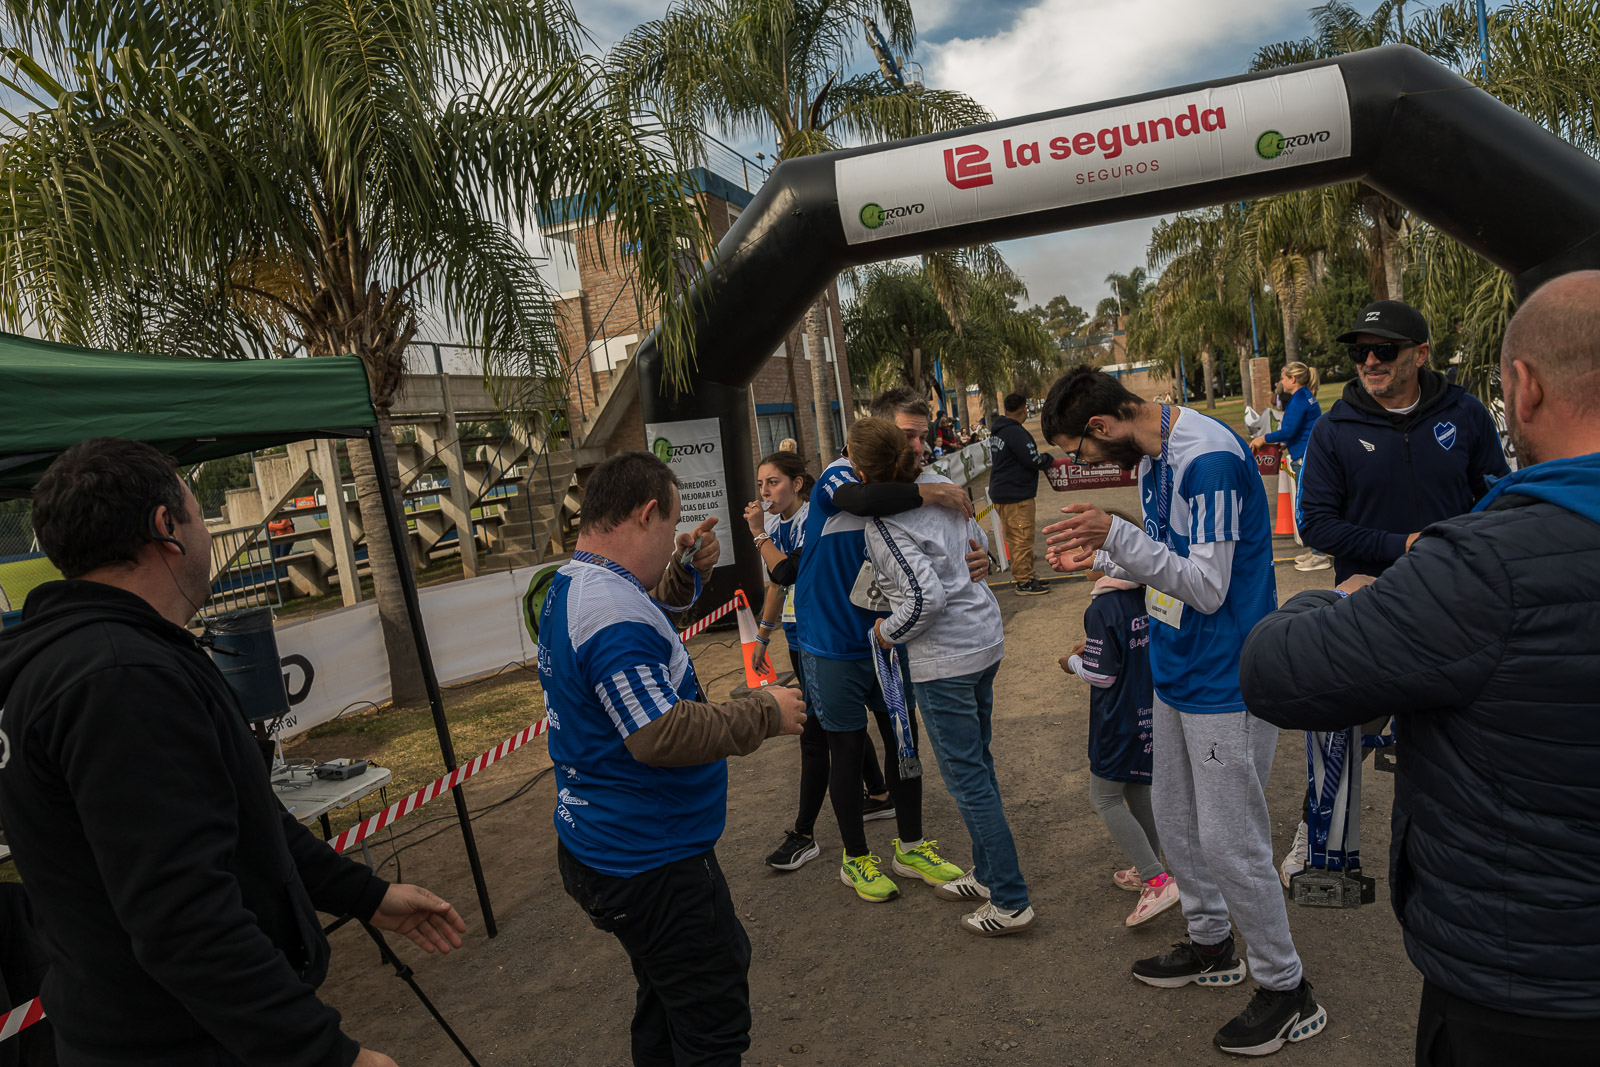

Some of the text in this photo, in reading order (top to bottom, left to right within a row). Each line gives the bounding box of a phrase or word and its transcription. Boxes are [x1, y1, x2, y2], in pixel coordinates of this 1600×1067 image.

[1002, 104, 1227, 169] la segunda
[1075, 159, 1160, 185] SEGUROS
[681, 490, 723, 501] MEJORAR LAS
[697, 503, 706, 511] DE
[707, 501, 719, 510] LOS
